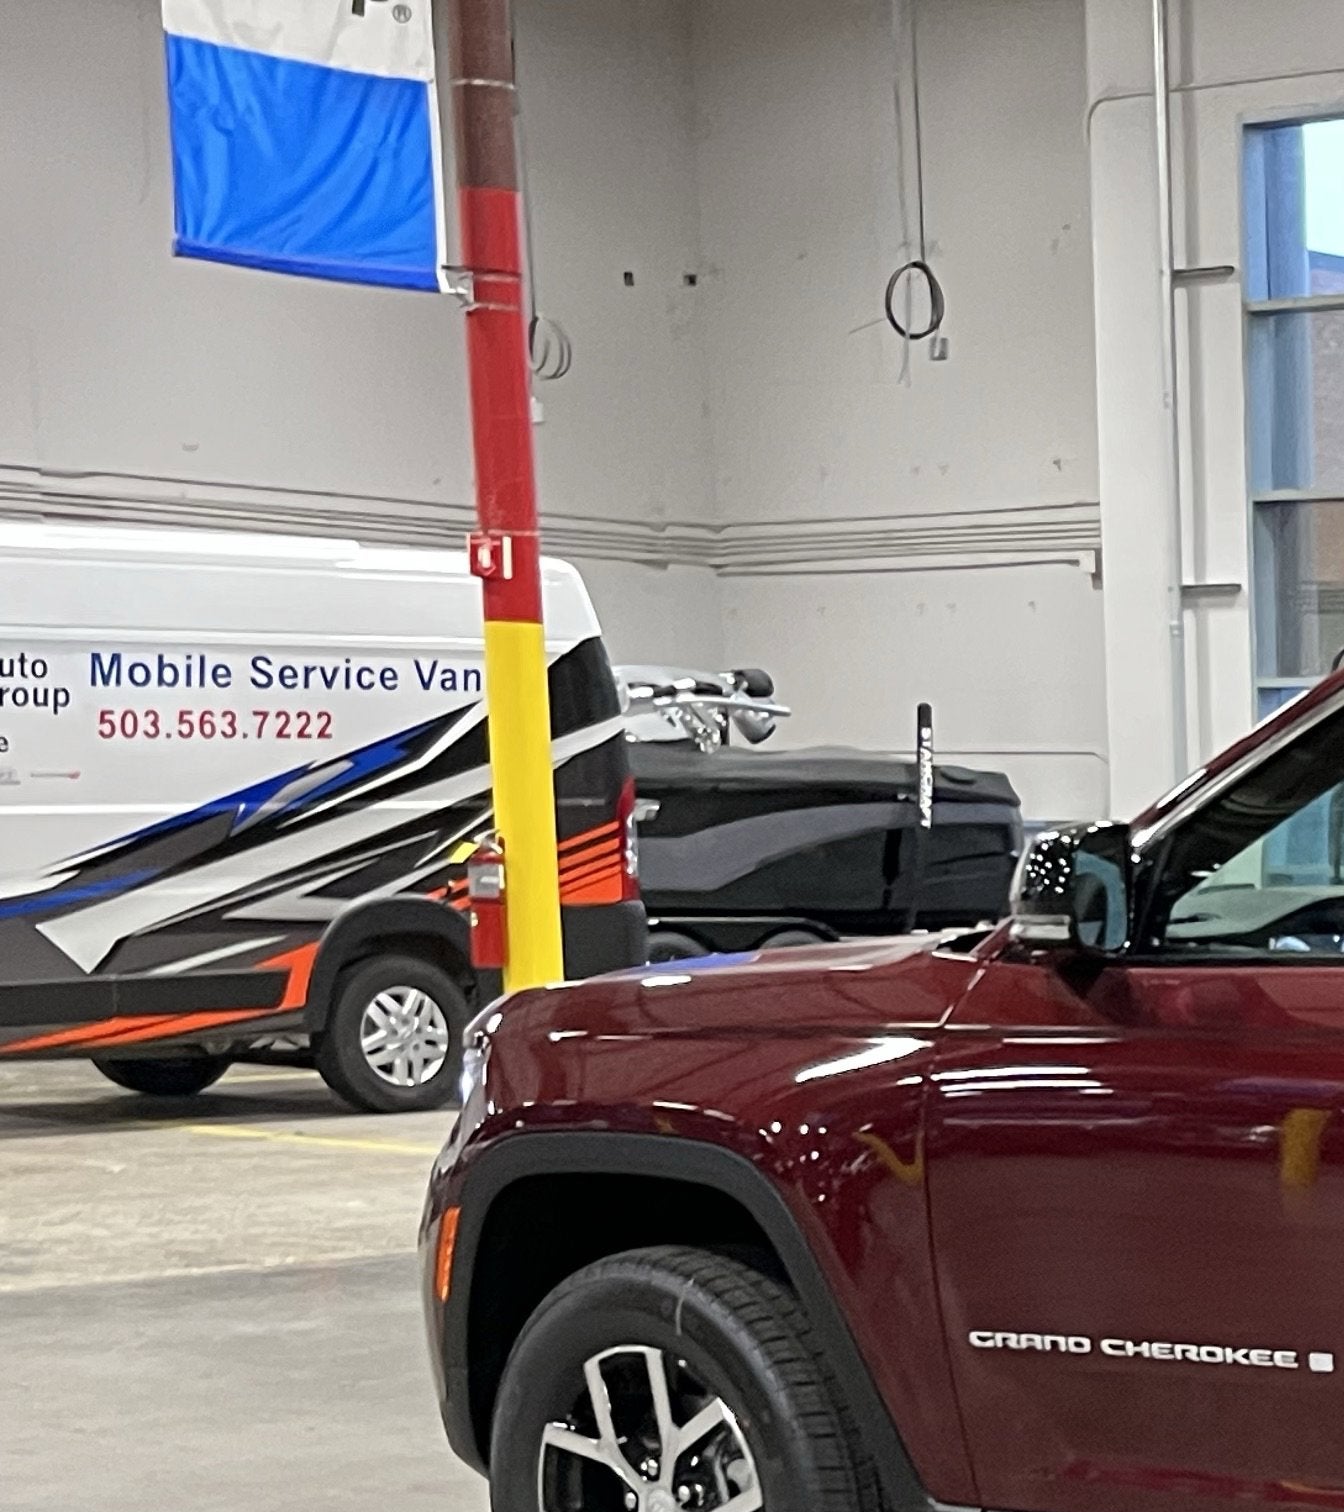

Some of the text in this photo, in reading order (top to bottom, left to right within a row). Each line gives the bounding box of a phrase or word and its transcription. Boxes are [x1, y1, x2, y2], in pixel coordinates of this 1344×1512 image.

[90, 652, 482, 692] Mobile Service Van
[98, 709, 333, 740] 503.563.7222
[968, 1330, 1298, 1369] GRAND CHEROKEE
